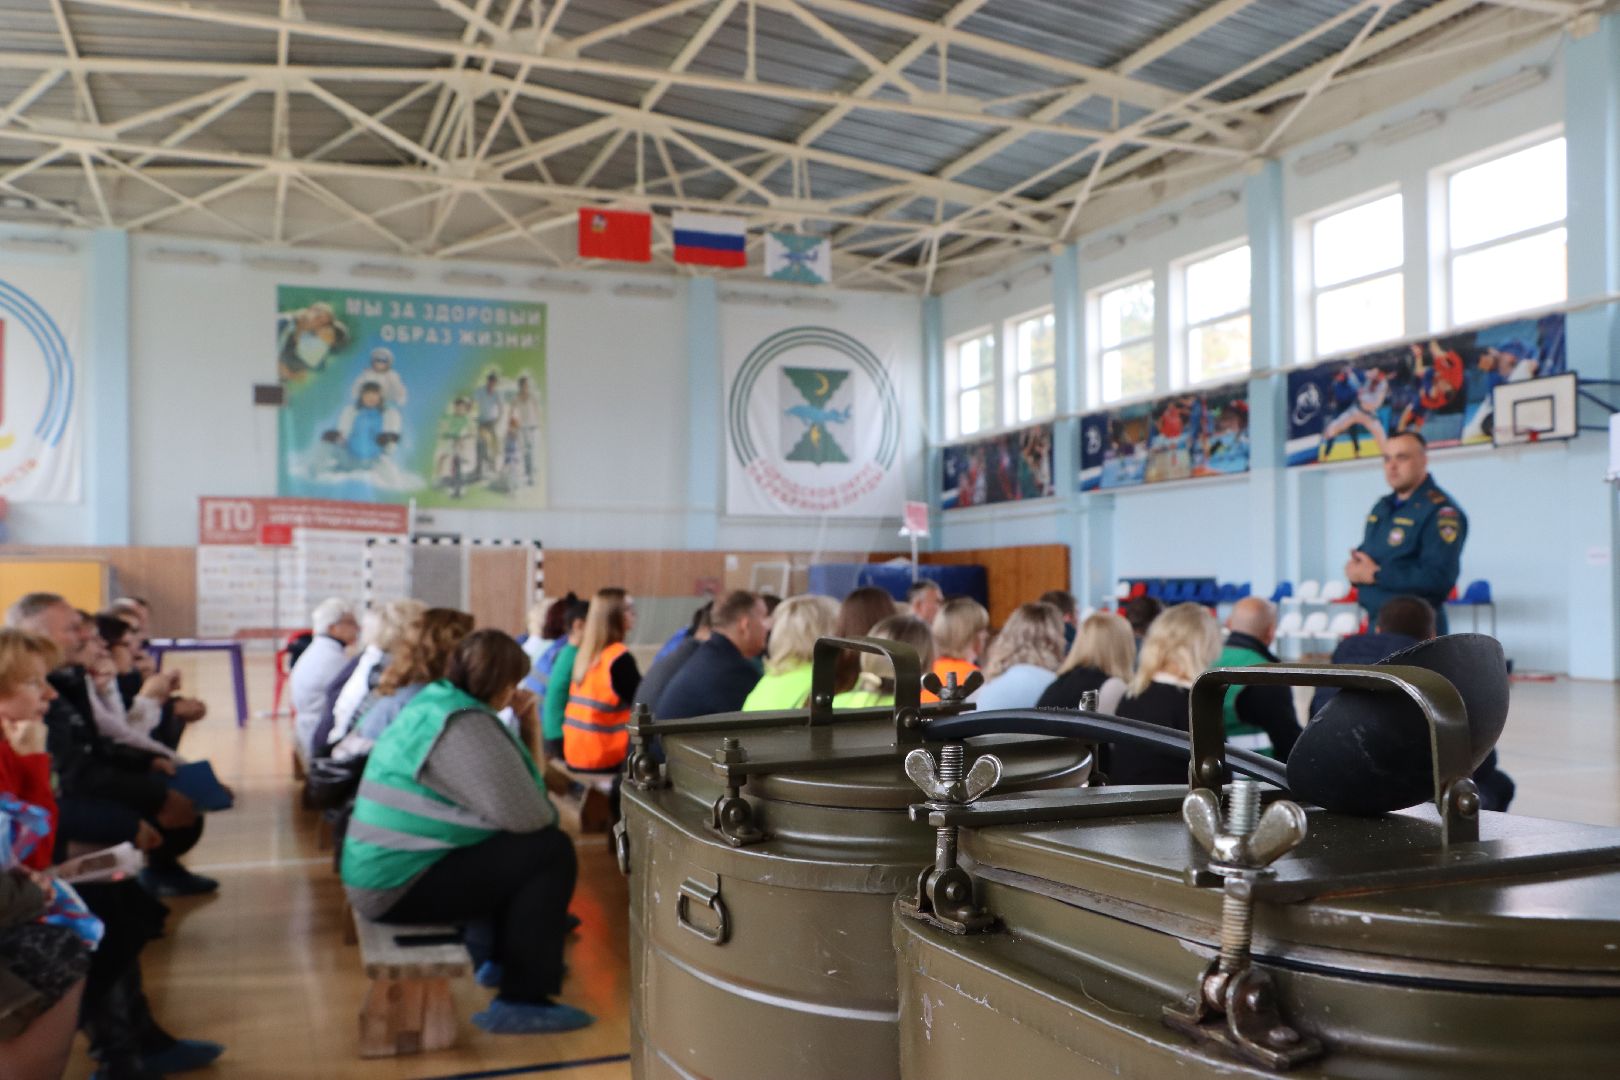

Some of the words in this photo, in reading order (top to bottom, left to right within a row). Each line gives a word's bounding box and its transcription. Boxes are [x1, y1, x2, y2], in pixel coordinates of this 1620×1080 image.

[345, 299, 383, 317] МЫ
[390, 302, 414, 319] ЗА
[380, 324, 452, 345] ОБРАЗ
